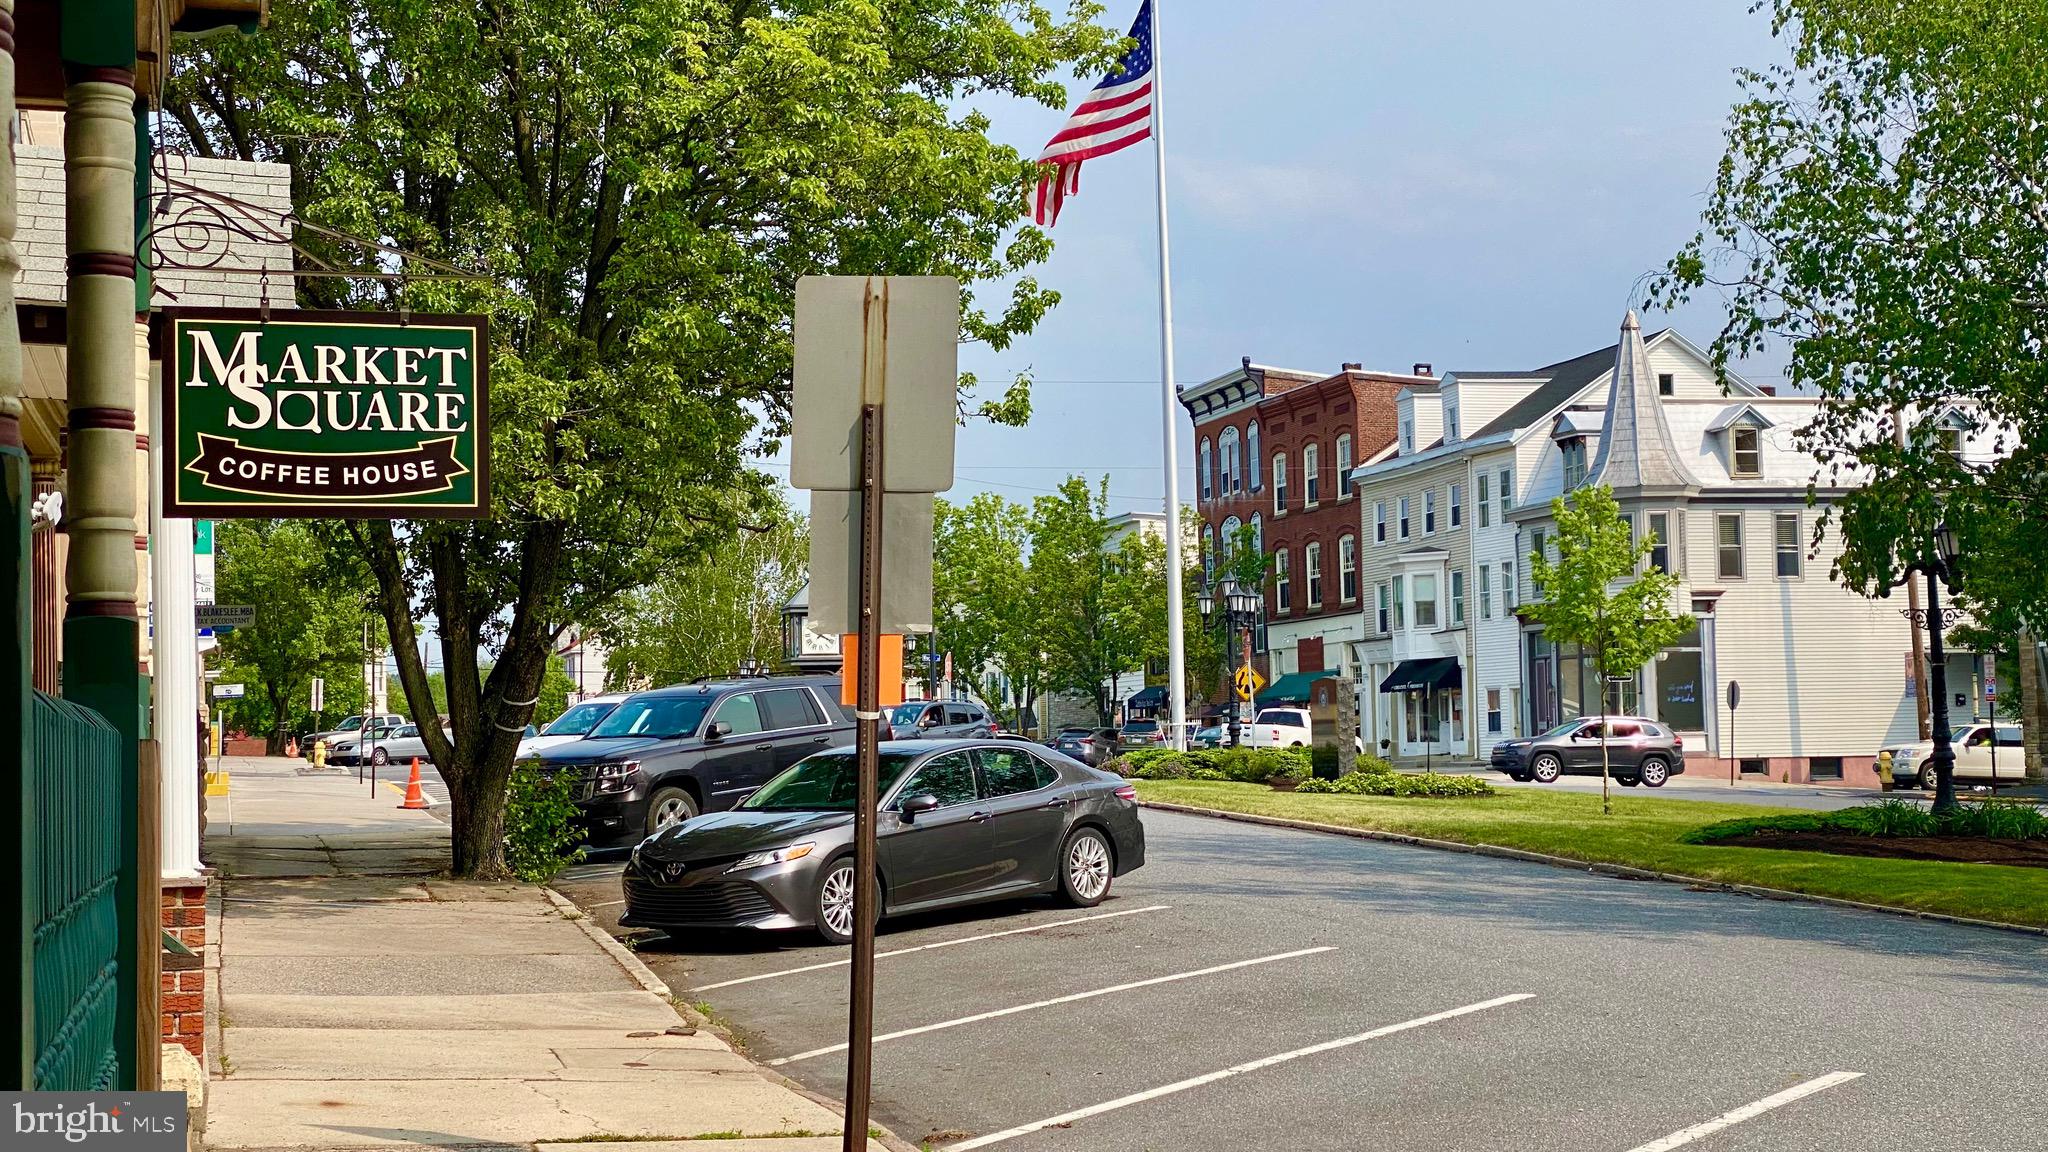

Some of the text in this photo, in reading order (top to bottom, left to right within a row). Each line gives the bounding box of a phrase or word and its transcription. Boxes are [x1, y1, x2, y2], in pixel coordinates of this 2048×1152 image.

[185, 330, 467, 388] MARKET
[226, 363, 468, 433] SQUARE
[218, 456, 438, 485] COFFEE HOUSE
